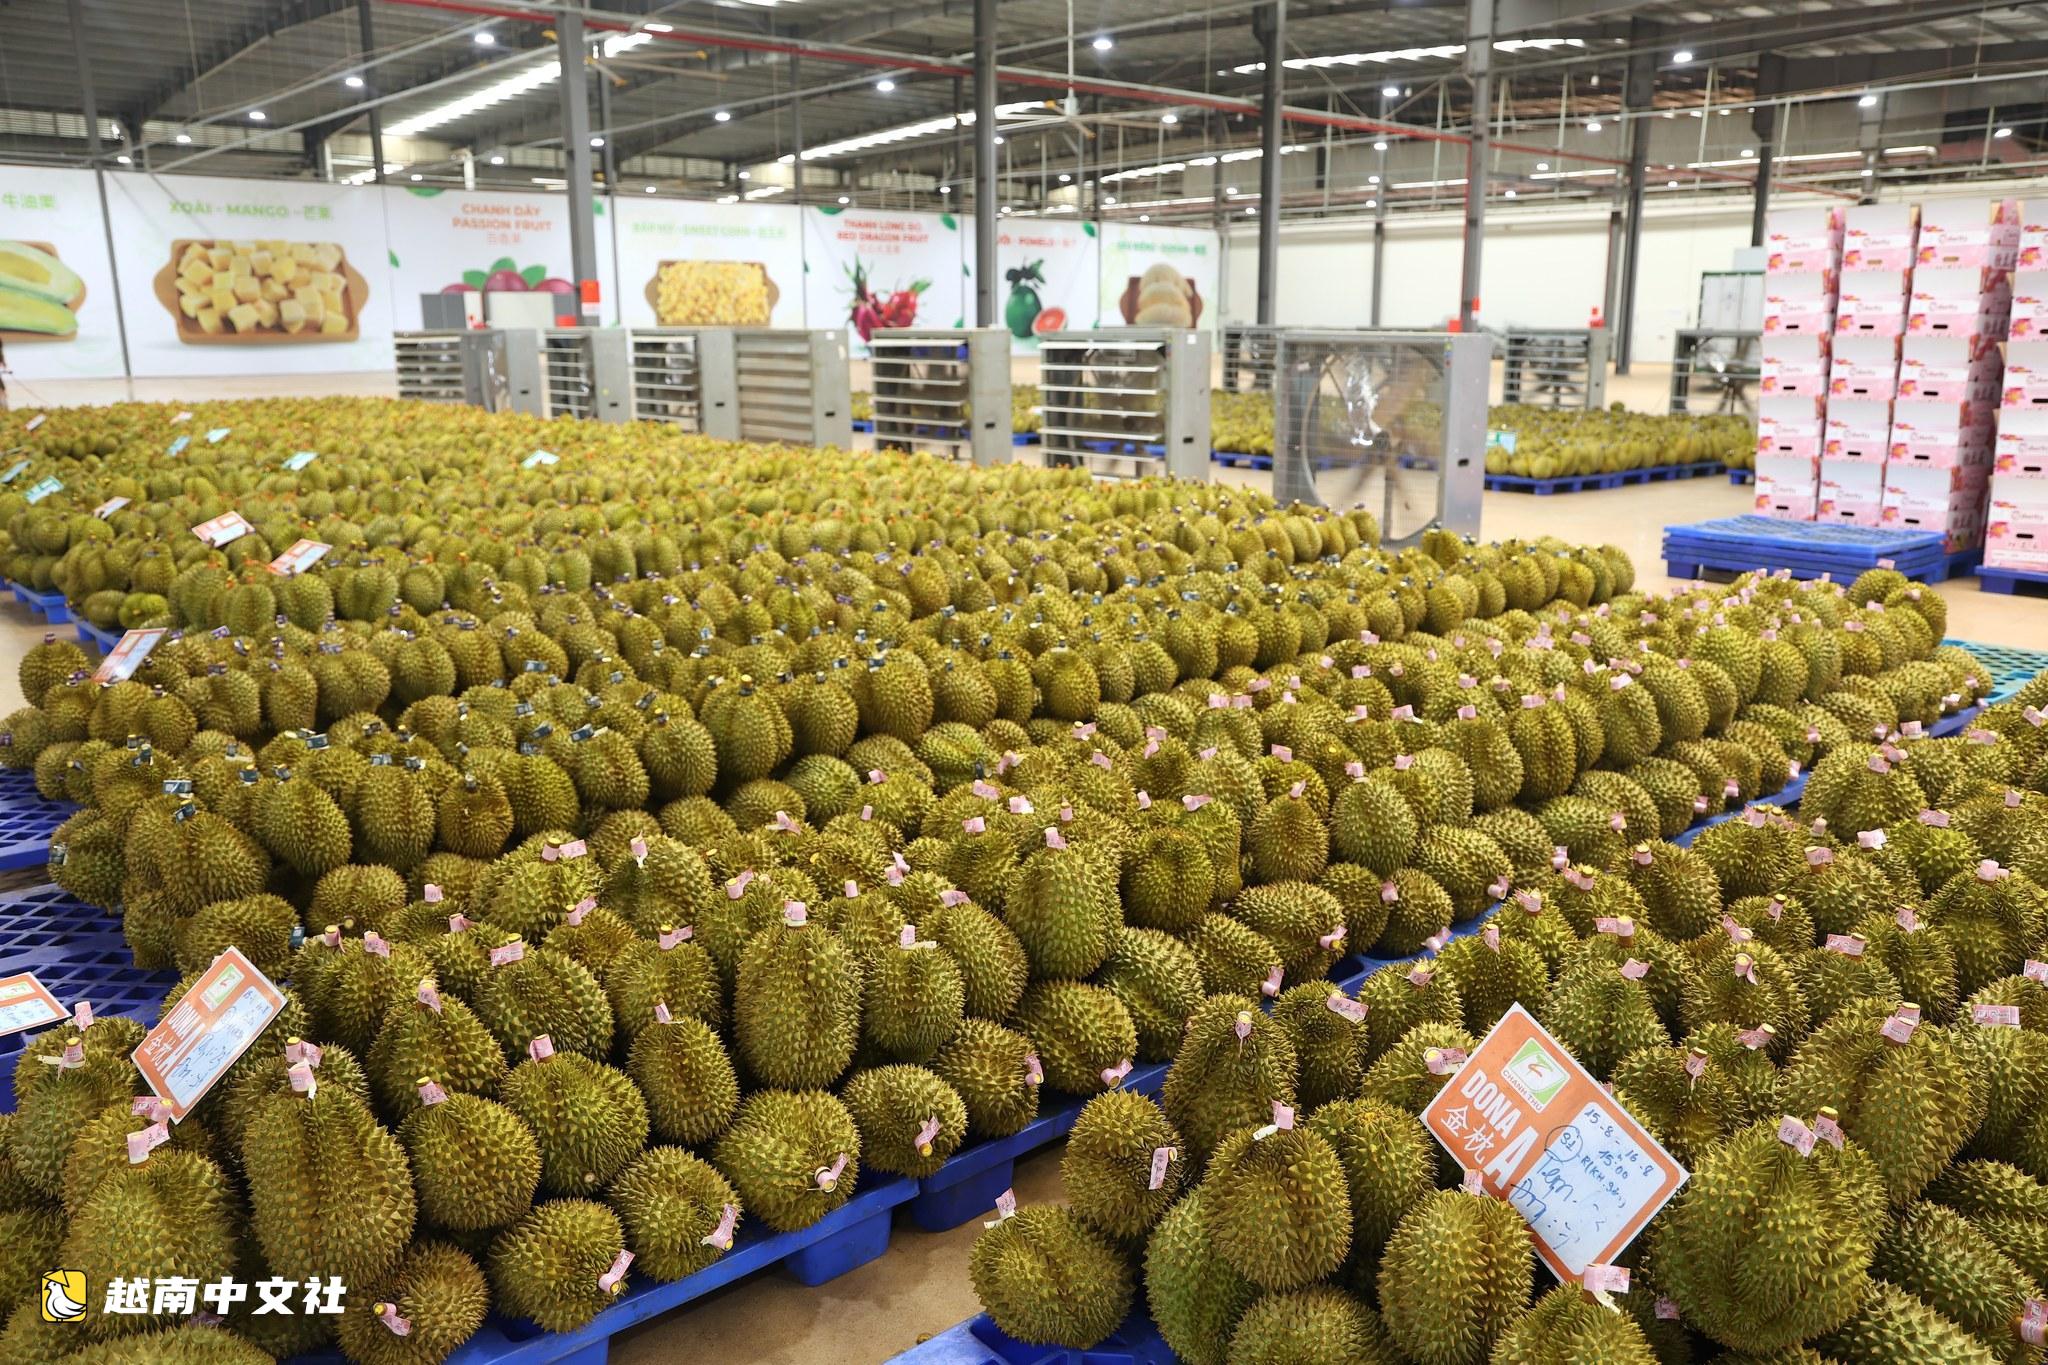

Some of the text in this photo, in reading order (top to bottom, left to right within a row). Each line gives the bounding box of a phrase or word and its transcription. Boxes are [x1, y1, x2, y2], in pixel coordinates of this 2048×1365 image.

[1460, 1069, 1521, 1139] DONA
[1502, 1069, 1543, 1111] CHANH THU
[1440, 1104, 1495, 1165] 金枕
[1482, 1125, 1540, 1190] A
